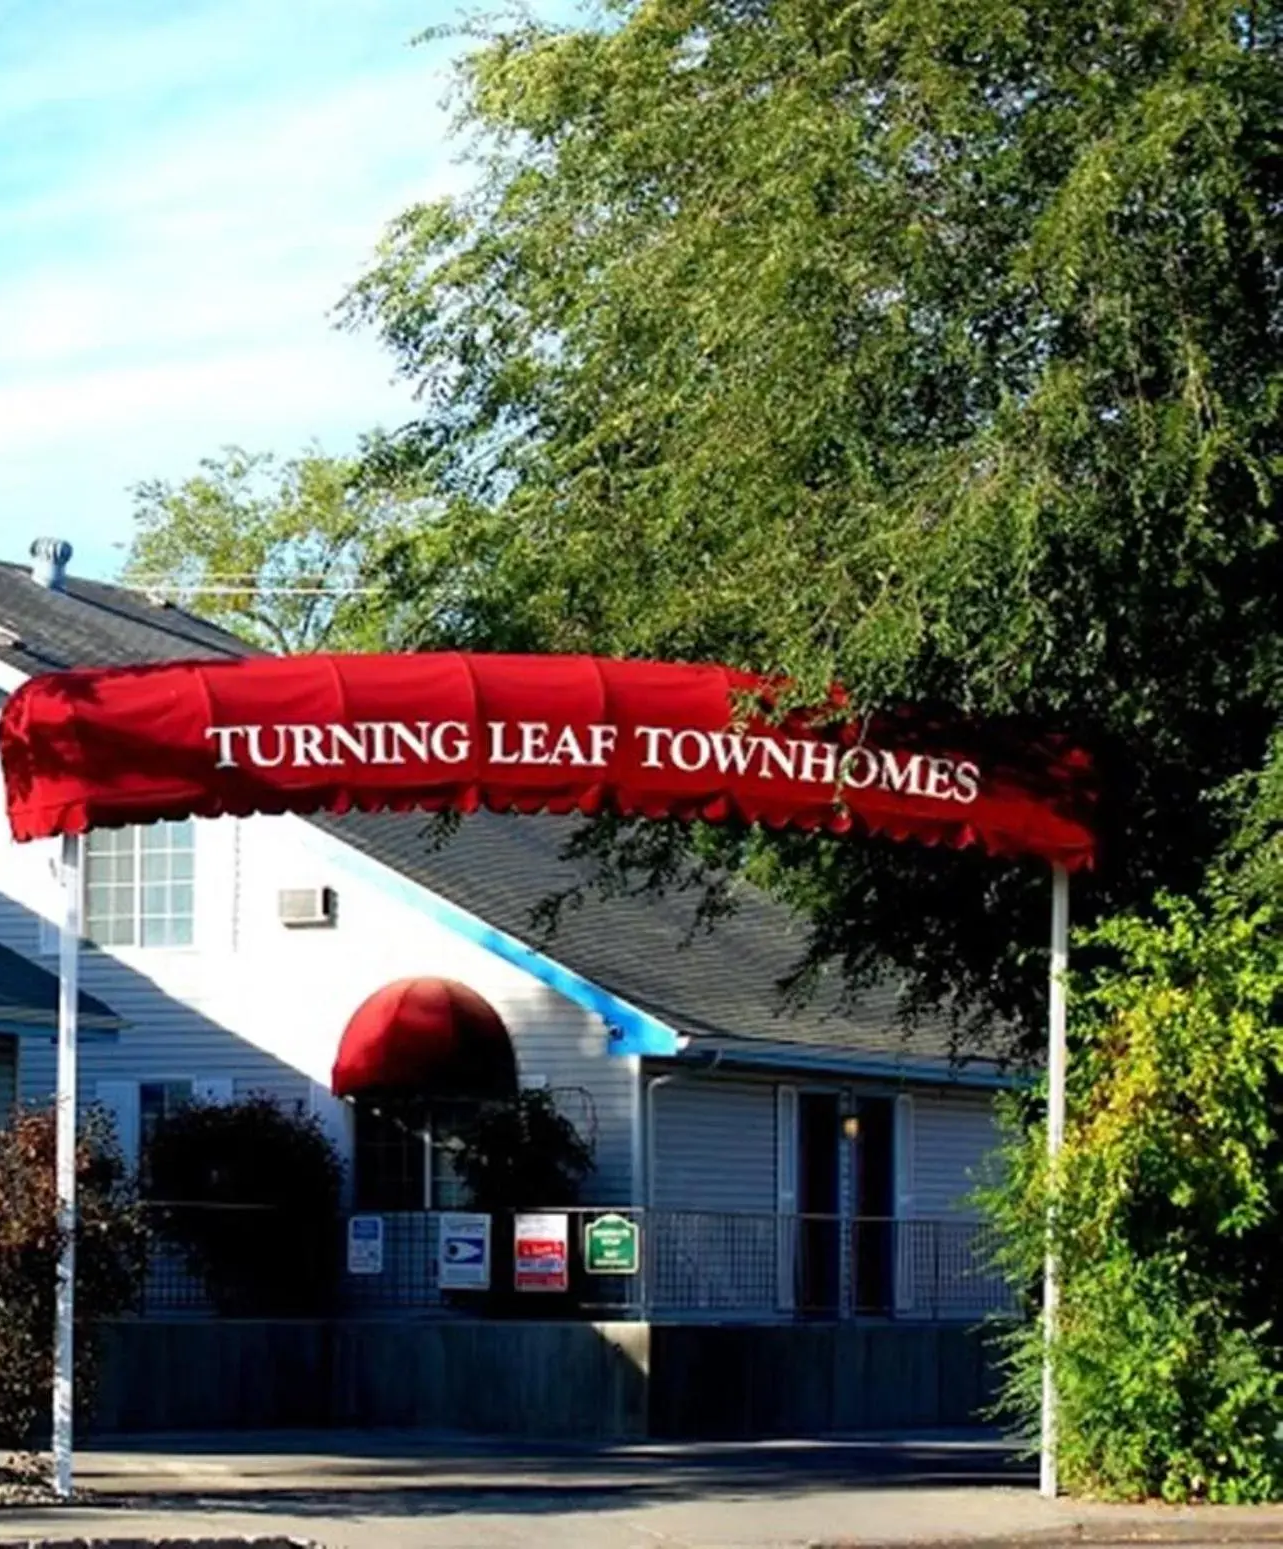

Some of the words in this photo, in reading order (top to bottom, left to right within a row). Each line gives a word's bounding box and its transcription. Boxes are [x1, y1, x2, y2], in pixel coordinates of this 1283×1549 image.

[204, 720, 472, 769] TURNING
[487, 721, 618, 767] LEAF
[634, 725, 982, 804] TOWNHOMES
